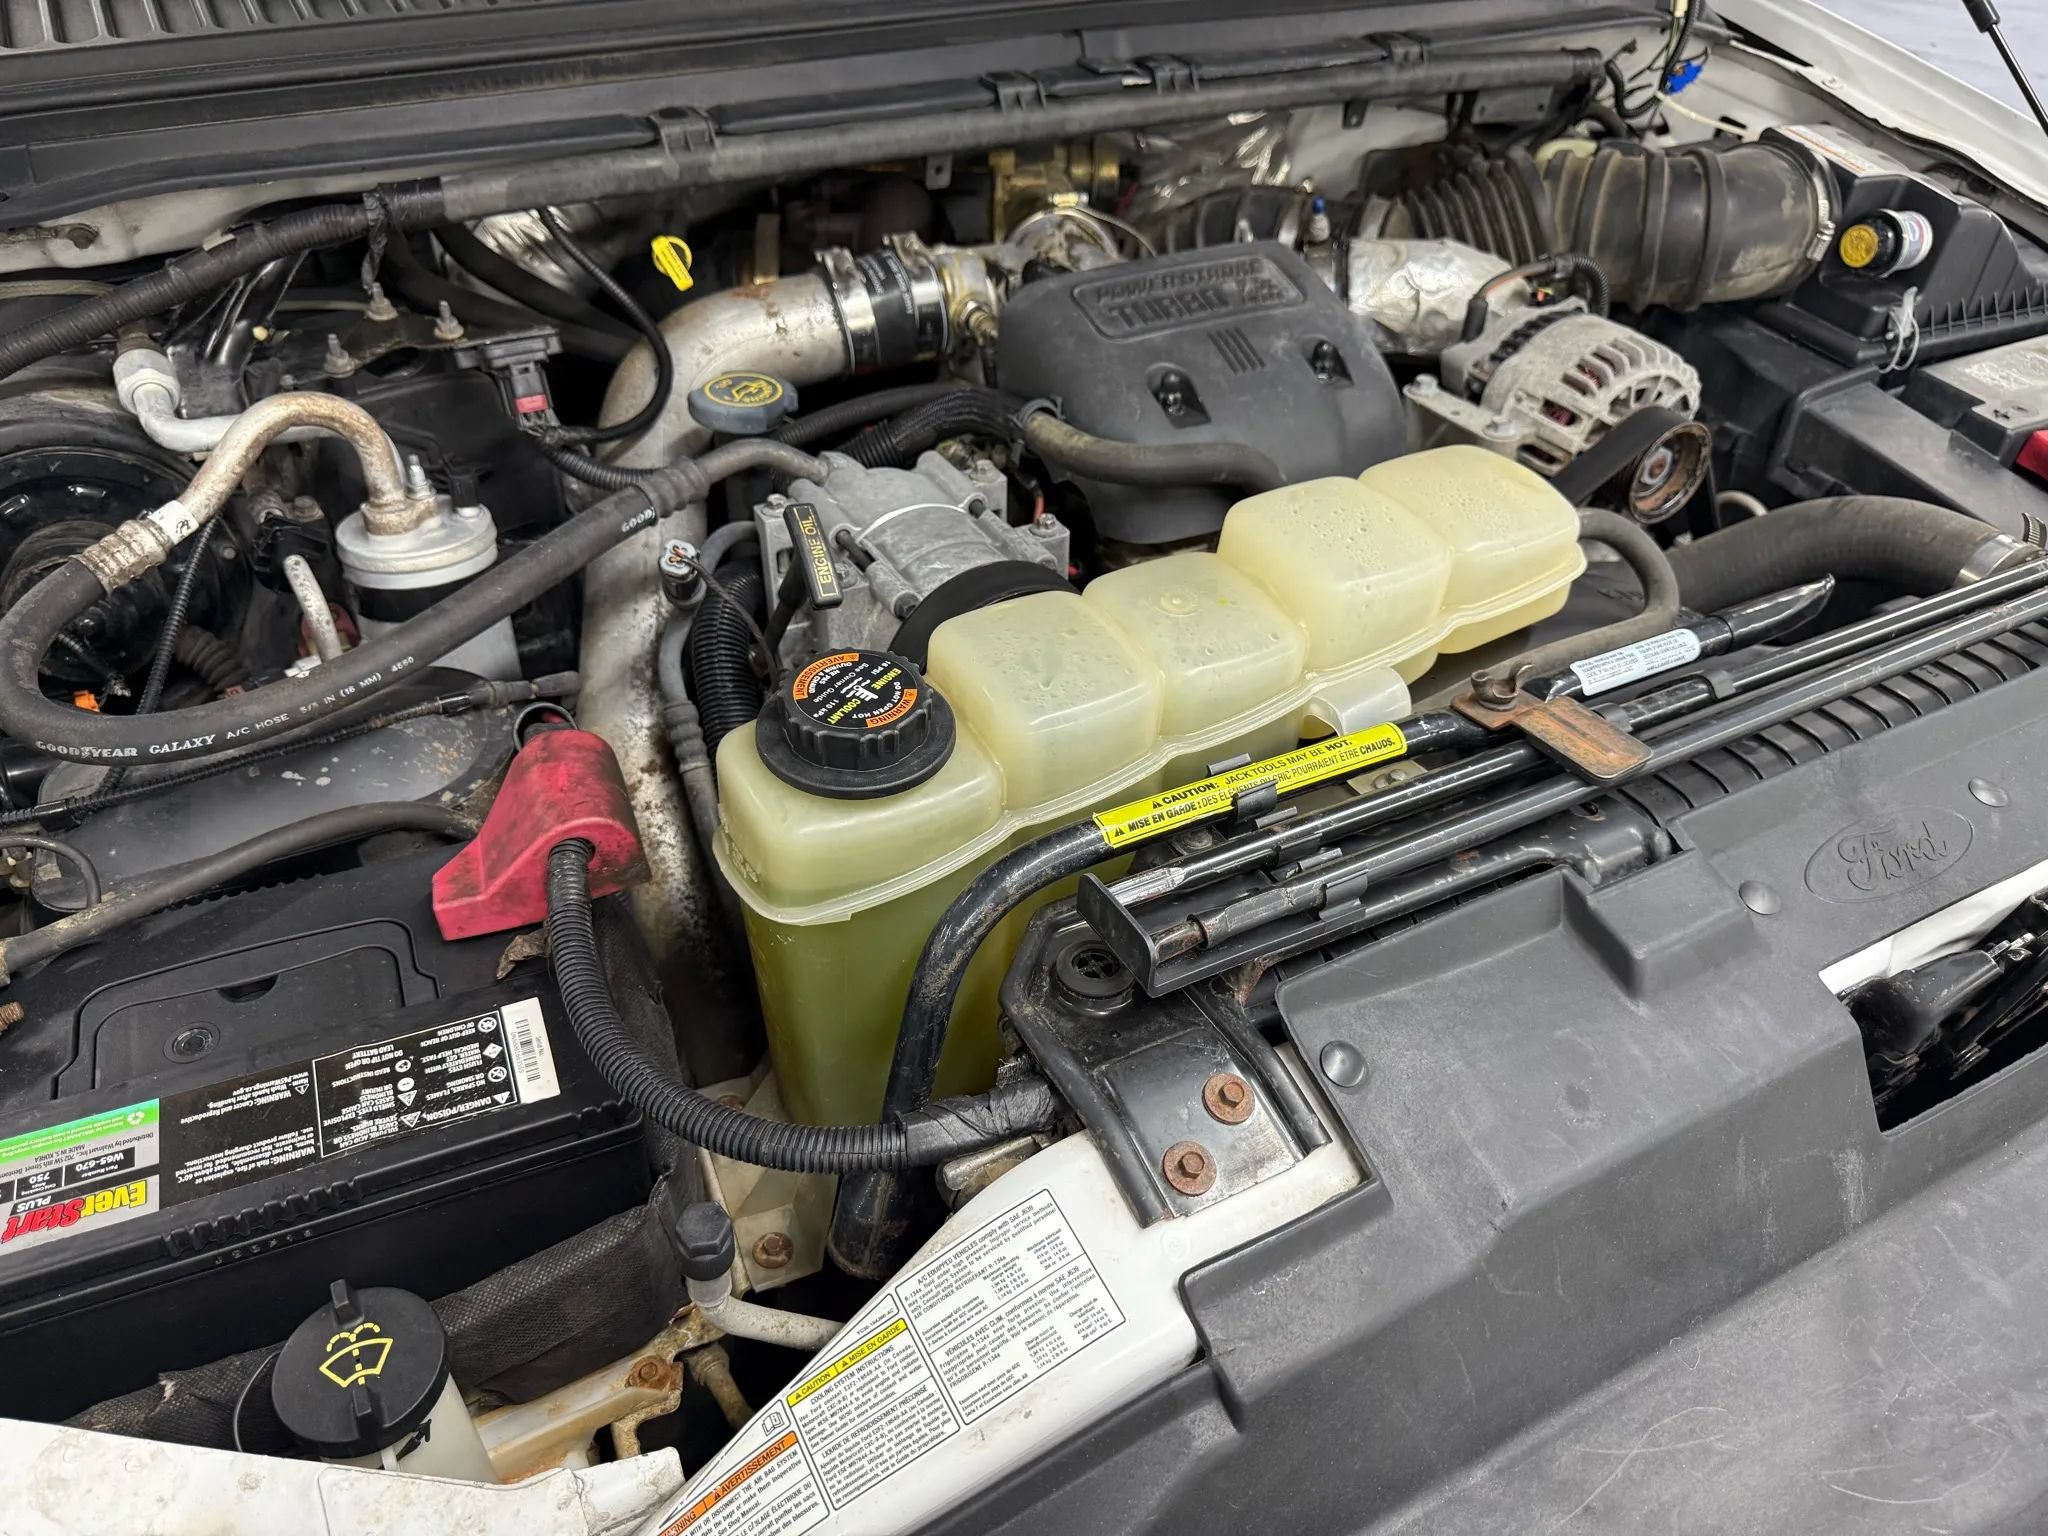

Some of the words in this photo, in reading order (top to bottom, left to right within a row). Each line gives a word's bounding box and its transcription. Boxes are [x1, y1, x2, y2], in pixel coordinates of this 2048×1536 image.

[801, 516, 817, 535] OIL
[809, 538, 832, 584] ENGINE
[796, 655, 844, 696] AVERTISSEMENT
[871, 665, 884, 675] PSI
[835, 672, 856, 688] Owner
[871, 668, 902, 690] ENGINE
[813, 688, 835, 703] Guide
[891, 690, 902, 704] NOT
[827, 699, 839, 709] 110
[35, 740, 138, 759] GOODYEAR
[149, 734, 216, 755] GALAXY
[226, 726, 251, 739] A/C
[255, 713, 289, 731] HOSE
[323, 694, 336, 704] IN
[360, 672, 382, 688] MM)
[813, 707, 829, 718] kPa
[827, 698, 861, 725] COOLANT
[870, 699, 911, 725] WARNING
[1161, 782, 1220, 805] CAUTION:
[1225, 770, 1252, 785] JACK
[1253, 759, 1287, 776] TOOLS
[1286, 753, 1311, 766] MAY
[1312, 747, 1326, 757] BE
[1325, 739, 1353, 752] HOT.
[1127, 818, 1151, 832] MISE
[1152, 811, 1166, 824] EN
[1201, 795, 1219, 807] DES
[1292, 755, 1340, 780] POURRAIENT
[1359, 737, 1396, 756] CHAUDS.
[1837, 820, 1948, 891] Ford
[352, 1048, 378, 1059] BATTERY
[378, 1044, 393, 1053] LEAD
[393, 1049, 403, 1057] DO
[436, 1049, 452, 1058] HELP
[452, 1042, 479, 1053] MEDICAL
[370, 1055, 381, 1063] TIP
[381, 1052, 393, 1061] NOT
[442, 1053, 481, 1068] IMMEDIATELY
[446, 1054, 457, 1062] GET
[344, 1059, 361, 1069] OPEN
[373, 1066, 390, 1075] READ
[424, 1064, 441, 1073] WITH
[463, 1059, 482, 1069] FLUSH
[291, 1077, 308, 1086] Harm
[331, 1070, 373, 1087] INSTRUCTIONS
[446, 1075, 474, 1087] SMOKING
[251, 1087, 269, 1097] hands
[270, 1083, 287, 1092] Wash
[425, 1088, 450, 1100] FLAMES
[236, 1092, 251, 1101] after
[254, 1090, 291, 1105] WARNING:
[220, 1105, 232, 1114] and
[233, 1099, 253, 1109] Cancer
[180, 1109, 220, 1123] Reproductive
[122, 1132, 153, 1145] Distributed
[68, 1144, 84, 1153] MADE
[89, 1143, 113, 1154] Walmart
[270, 1146, 315, 1164] WARNING:
[34, 1152, 52, 1162] KOREA
[75, 1152, 123, 1171] W65-670
[24, 1162, 41, 1172] Street
[248, 1162, 255, 1170] of
[29, 1171, 49, 1184] 750
[203, 1168, 233, 1181] explosion
[16, 1195, 51, 1212] PLUS
[1, 1179, 147, 1244] EverStart
[917, 1274, 927, 1284] A/C
[926, 1257, 952, 1277] EQUIPPED
[952, 1240, 977, 1259] VEHICLES
[978, 1228, 997, 1243] comply
[997, 1220, 1009, 1230] with
[1008, 1212, 1020, 1222] SAE
[1021, 1205, 1033, 1215] J639
[944, 1334, 974, 1356] VÉHICULES
[974, 1324, 989, 1337] AVEC
[1004, 1296, 1033, 1317] conformes
[1037, 1282, 1054, 1295] norme
[1054, 1273, 1066, 1284] SAE
[1067, 1265, 1079, 1277] J639
[801, 1371, 830, 1394] CAUTION
[848, 1347, 865, 1362] MISE
[865, 1340, 876, 1350] EN
[876, 1324, 900, 1343] GARDE
[810, 1385, 833, 1404] COOLING
[833, 1370, 855, 1388] SYSTEM
[855, 1344, 894, 1373] INSTRUCTIONS
[821, 1441, 842, 1458] LIQUIDE
[842, 1435, 850, 1444] DE
[850, 1404, 897, 1438] REFROIDISSEMENT
[721, 1440, 786, 1495] AVERTISSEMENT
[710, 1492, 742, 1520] DISCONNECT
[742, 1485, 754, 1495] THE
[754, 1476, 764, 1486] AIR
[764, 1468, 775, 1479] BAG
[776, 1450, 799, 1472] SYSTEM
[727, 1514, 741, 1528] Shop
